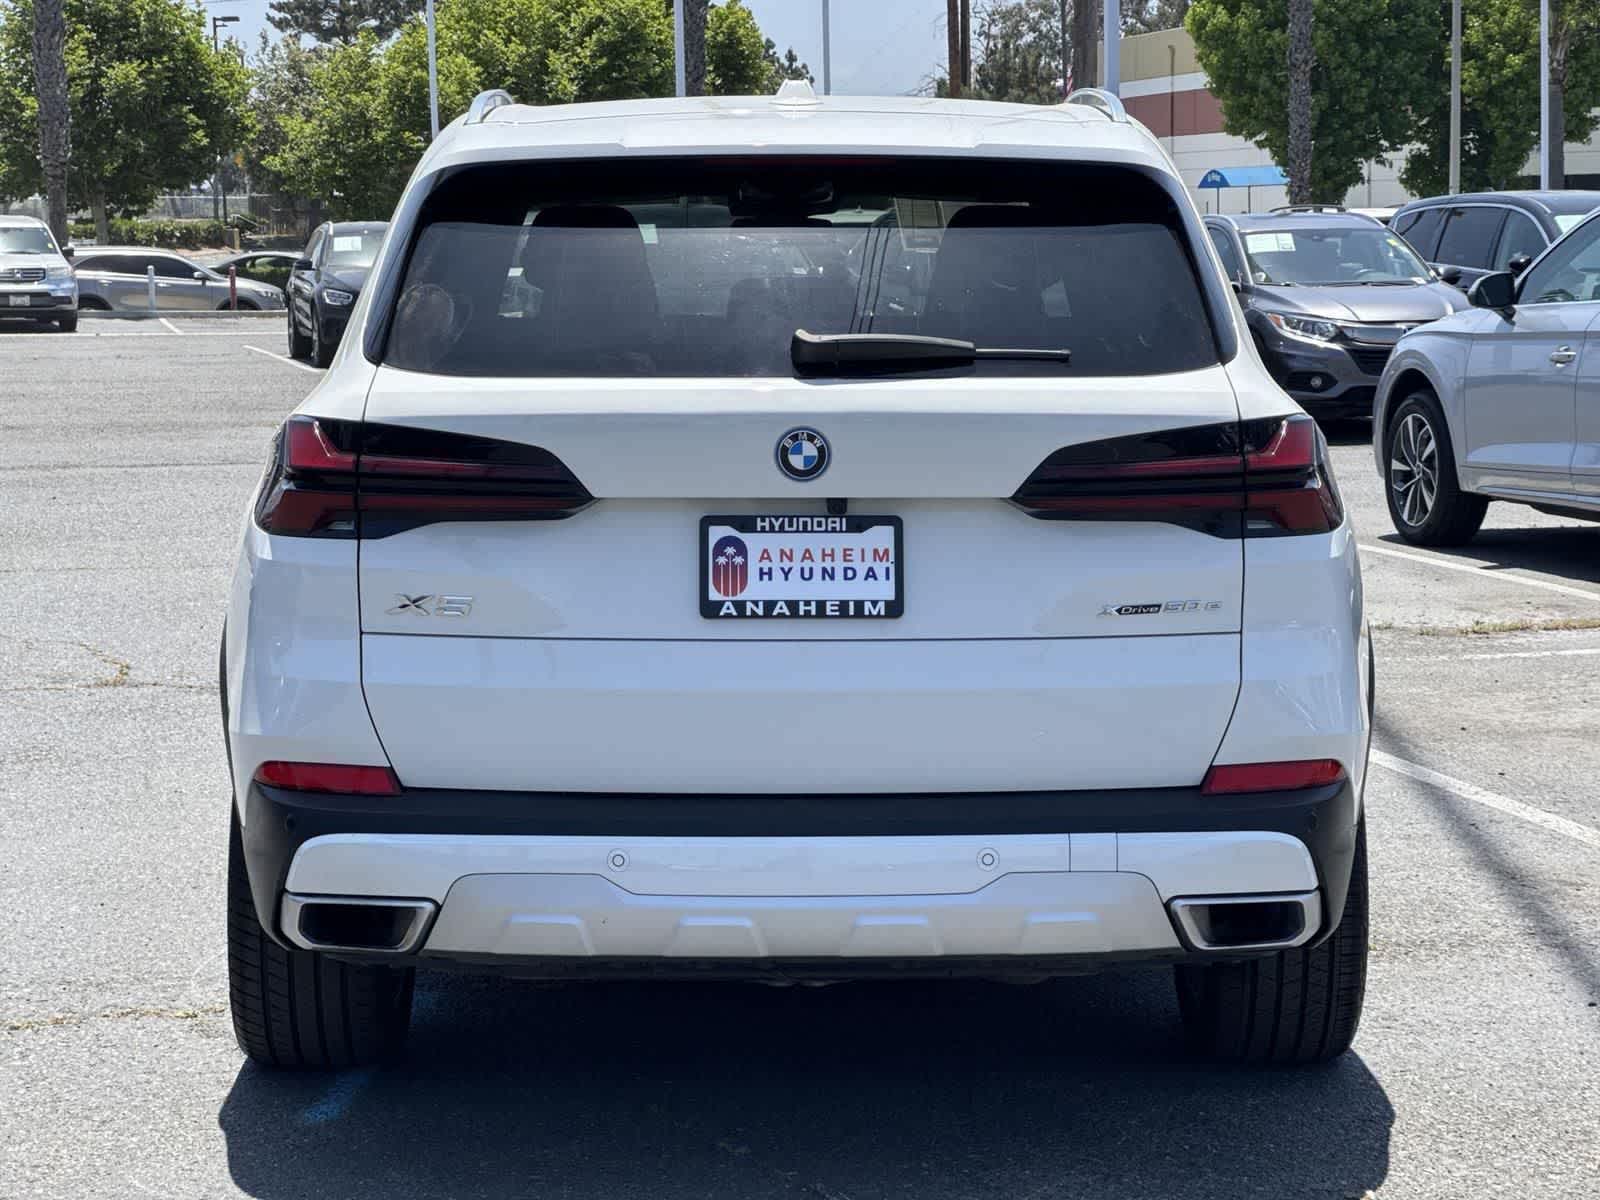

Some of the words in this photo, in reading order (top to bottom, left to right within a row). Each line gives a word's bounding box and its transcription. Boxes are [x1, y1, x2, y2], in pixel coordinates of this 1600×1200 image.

[784, 431, 823, 448] BMW
[756, 517, 847, 531] HYUNDAI
[758, 548, 890, 562] ANAHEIM
[758, 566, 890, 581] HYUNDAI
[384, 592, 473, 616] X5
[719, 600, 886, 616] ANAHEIM
